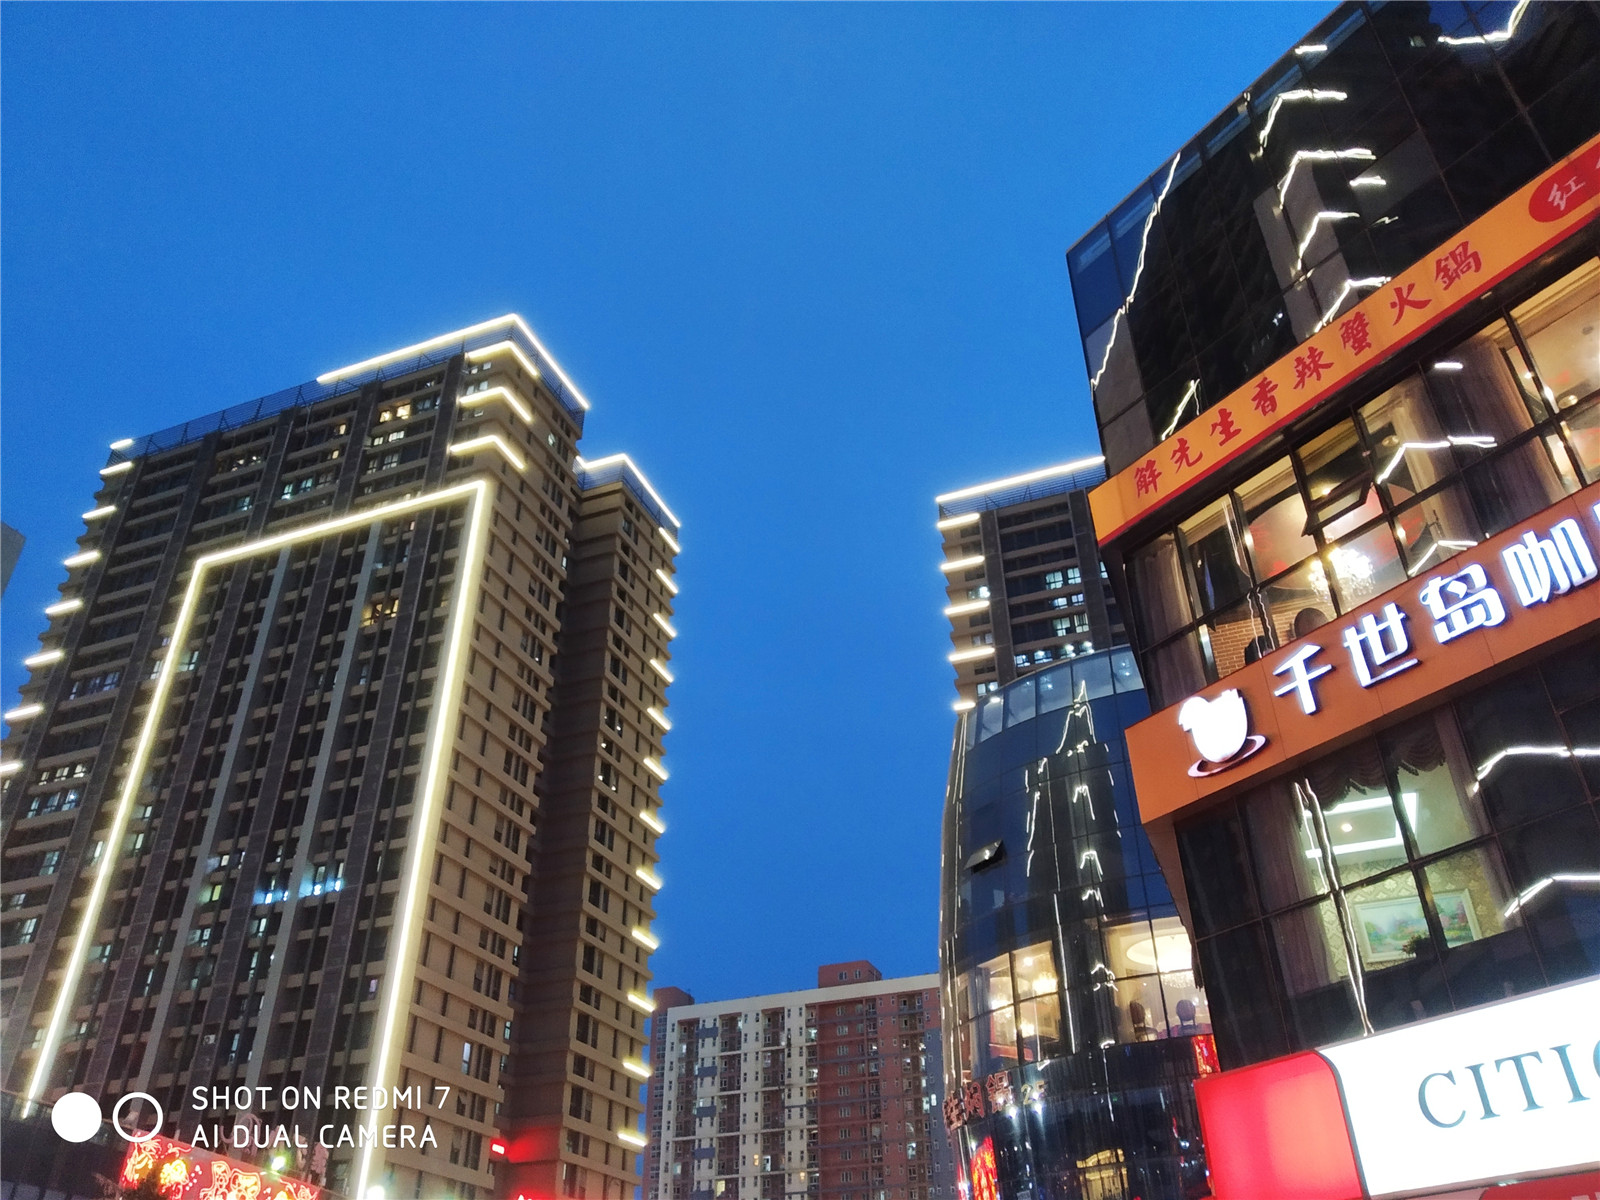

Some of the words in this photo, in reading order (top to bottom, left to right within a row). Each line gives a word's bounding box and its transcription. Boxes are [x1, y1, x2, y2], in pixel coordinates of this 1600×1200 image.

[1547, 155, 1600, 211] 红
[1273, 500, 1600, 715] 千世岛咖
[1418, 1040, 1600, 1129] CITI
